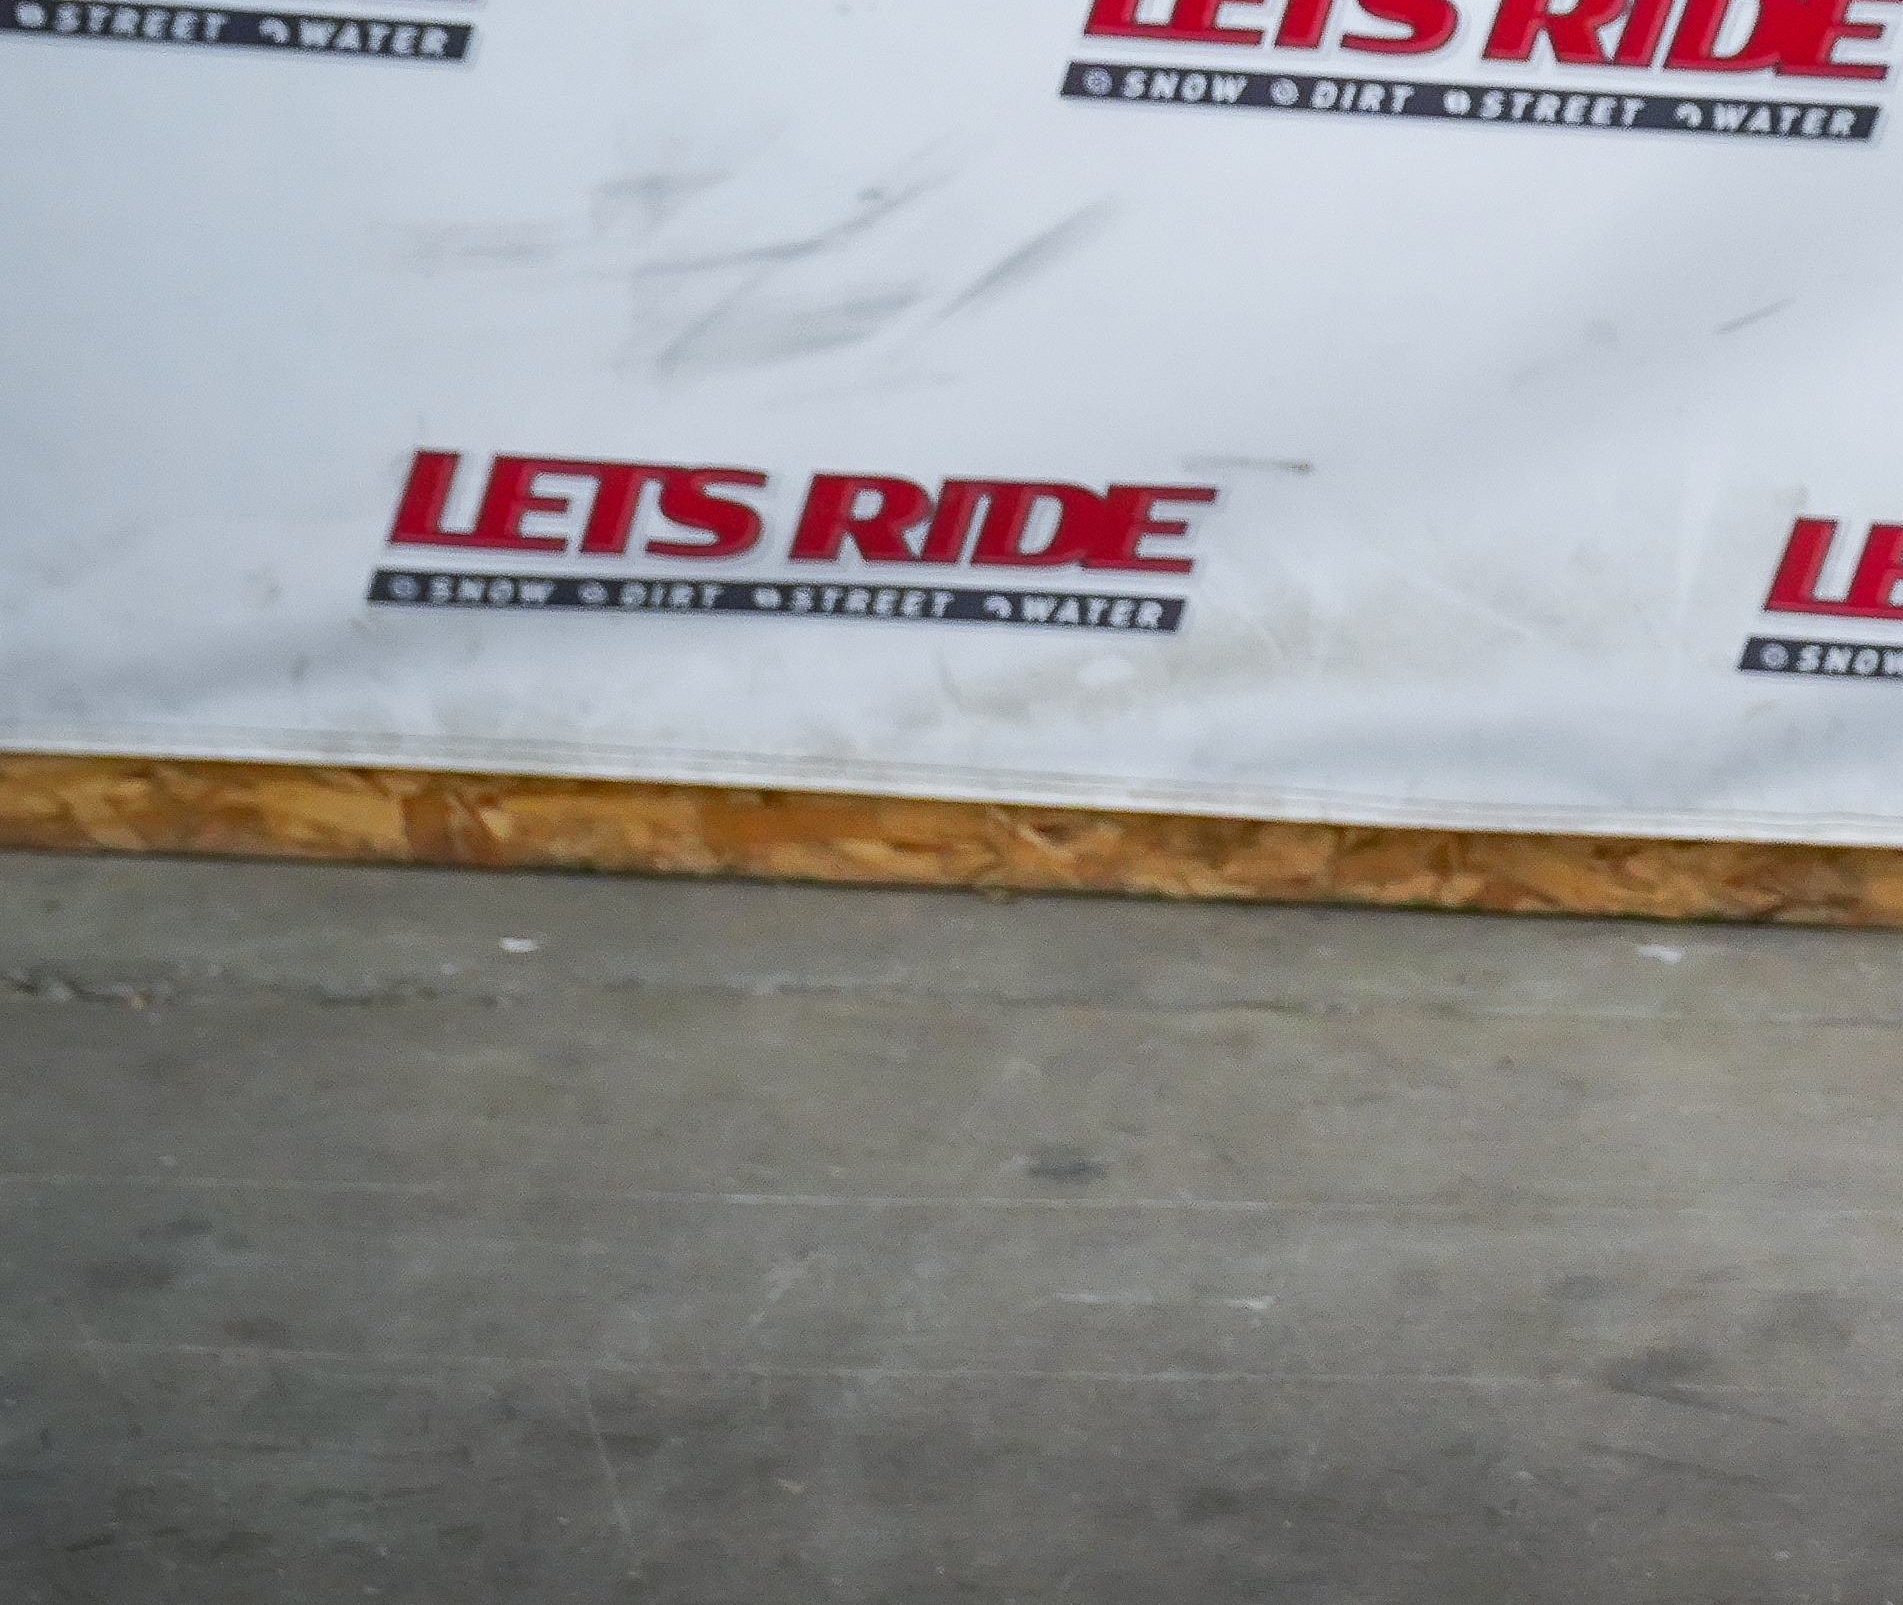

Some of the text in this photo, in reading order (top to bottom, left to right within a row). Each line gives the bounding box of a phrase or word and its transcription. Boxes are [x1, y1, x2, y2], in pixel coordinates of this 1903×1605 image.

[54, 0, 449, 56] STREET WATER
[1120, 69, 1857, 137] SNOW DIRT STREET WATER
[389, 450, 1214, 574] LETS RIDE
